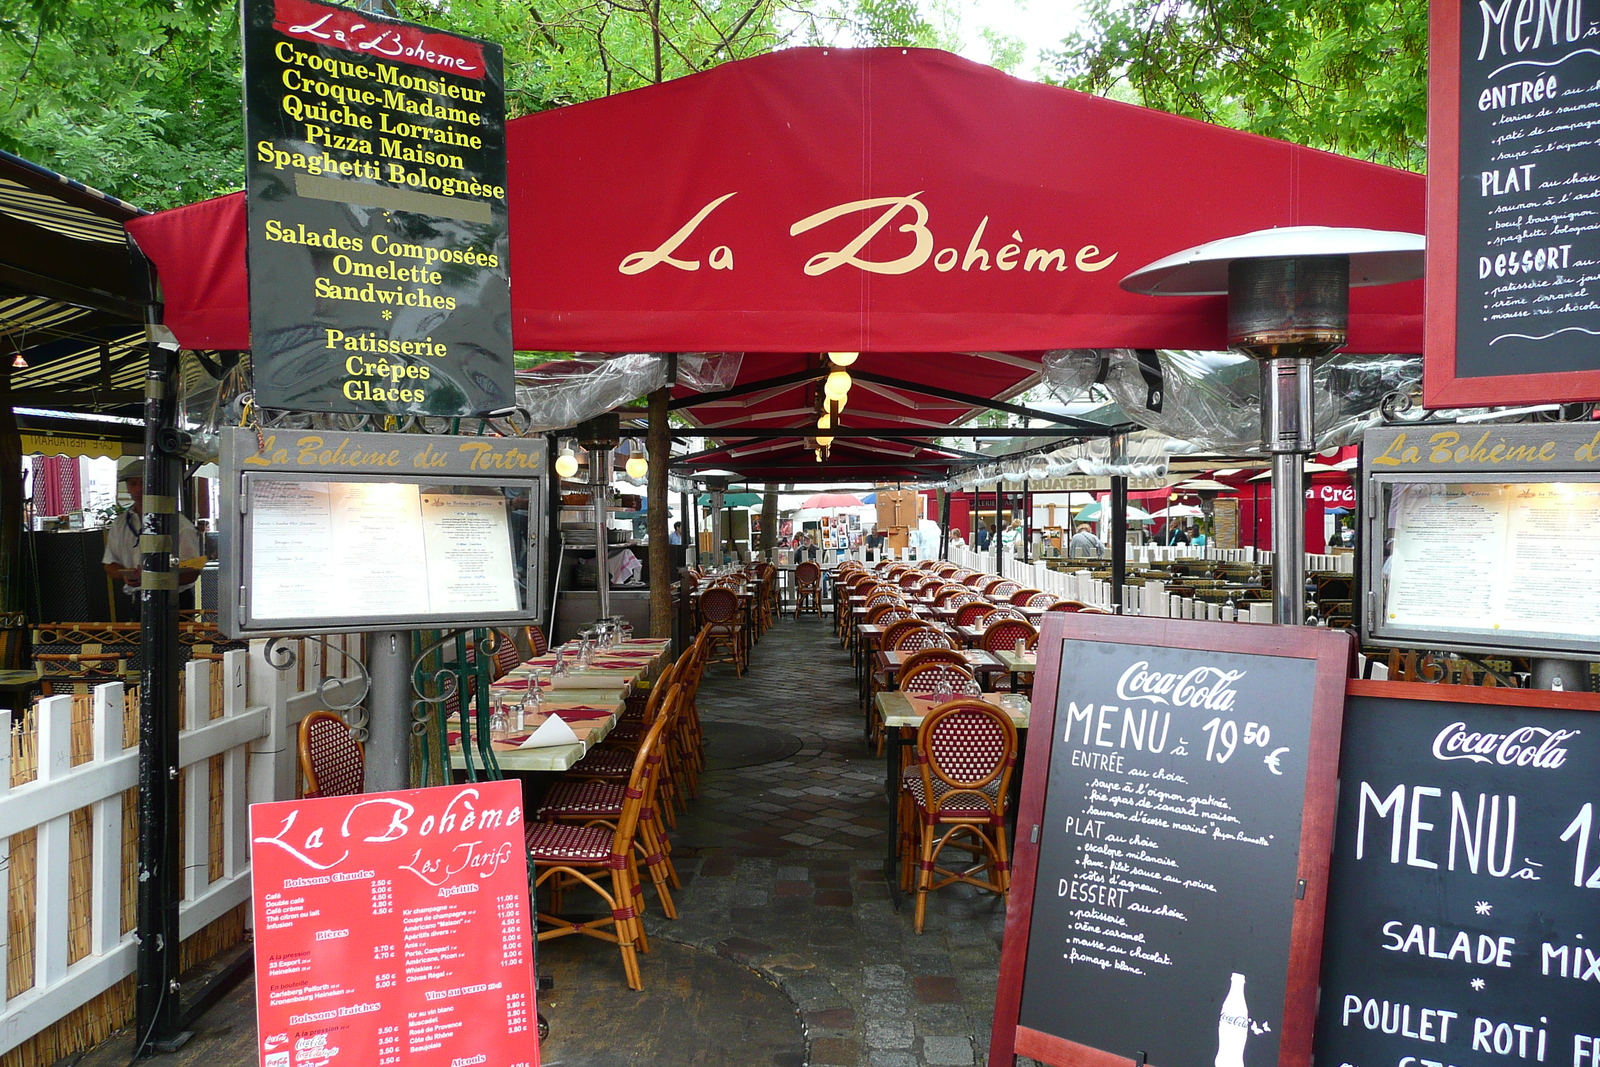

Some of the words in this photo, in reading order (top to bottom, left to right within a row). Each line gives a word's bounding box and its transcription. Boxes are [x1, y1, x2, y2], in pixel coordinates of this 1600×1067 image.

[288, 13, 345, 42] La
[275, 41, 486, 104] Croque-Monsieur
[282, 68, 481, 126] Croque-Madame
[1561, 88, 1584, 97] au
[282, 94, 373, 129] Quiche
[379, 112, 482, 150] Lorraine
[1535, 107, 1553, 118] de
[304, 123, 373, 154] Pizza
[379, 137, 464, 170] Maison
[1527, 127, 1546, 137] de
[257, 140, 382, 181] Spaghetti
[387, 163, 505, 200] Bolognèse
[1481, 163, 1536, 197] PLAT
[1538, 181, 1561, 189] au
[1494, 202, 1541, 214] saumon
[265, 220, 363, 253] Salades
[371, 233, 499, 268] Composées
[618, 191, 738, 275] La
[789, 190, 1119, 276] Bohème
[332, 255, 442, 286] Omelette
[314, 277, 457, 311] Sandwiches
[325, 329, 448, 358] Patisserie
[345, 354, 431, 382] Crêpes
[343, 379, 426, 403] Glaces
[243, 435, 290, 467] La
[296, 436, 401, 467] Bohème
[413, 443, 448, 469] du
[459, 442, 540, 470] Tertre
[1372, 432, 1422, 467] La
[1428, 430, 1557, 465] Bohème
[1063, 701, 1171, 754] MENU
[1432, 721, 1577, 769] Coca-Cola
[1071, 750, 1125, 774] ENTRÉE
[1128, 767, 1150, 778] au
[1091, 778, 1121, 793] soupe
[253, 810, 350, 870] La
[341, 788, 522, 843] Bohème
[1065, 816, 1106, 839] PLAT
[1105, 834, 1127, 843] au
[1355, 780, 1517, 879] MENU
[332, 870, 375, 883] Chaudes
[398, 848, 450, 887] Les
[446, 841, 512, 879] Tarifs
[413, 904, 448, 915] champagne
[1058, 878, 1129, 909] DESSERT
[1127, 902, 1151, 913] au
[315, 929, 349, 941] Bières
[1107, 945, 1127, 954] au
[1381, 920, 1516, 969] SALADE
[425, 990, 447, 1001] Vins
[1342, 994, 1458, 1044] POULET
